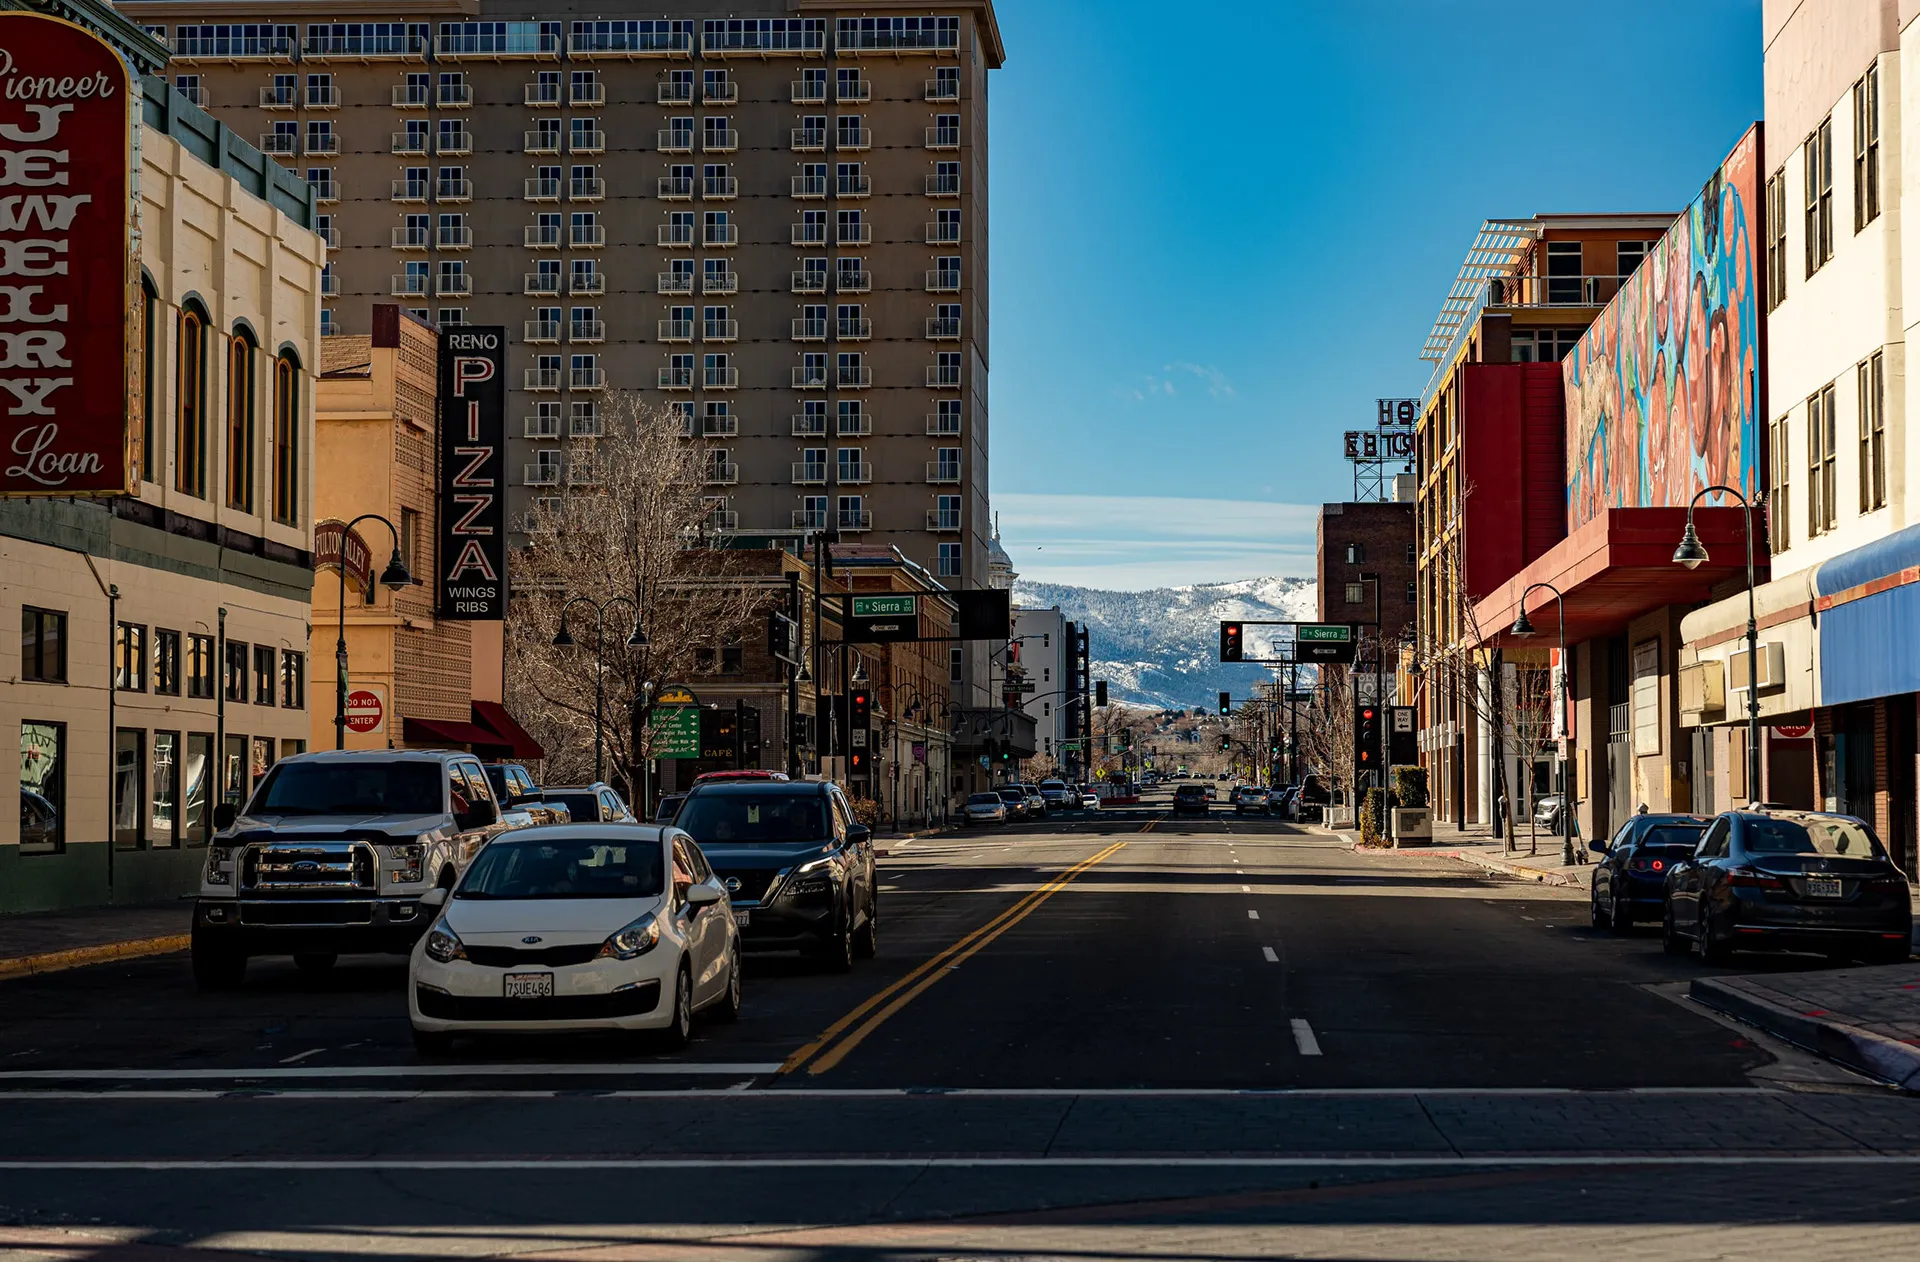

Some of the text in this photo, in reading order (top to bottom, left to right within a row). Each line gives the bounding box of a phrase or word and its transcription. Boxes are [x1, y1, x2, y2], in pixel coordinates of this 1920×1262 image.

[0, 103, 91, 415] JEWELRY
[449, 334, 498, 350] RENO
[5, 423, 104, 486] Loan
[447, 356, 498, 581] PIZZA
[316, 531, 366, 573] FULTON ALLEY
[448, 587, 496, 598] WINGS
[456, 601, 489, 613] RIBS
[872, 601, 900, 612] Sierra
[1314, 629, 1338, 639] Sierra
[704, 748, 733, 757] CAFÉ
[507, 982, 551, 996] 7SUE486
